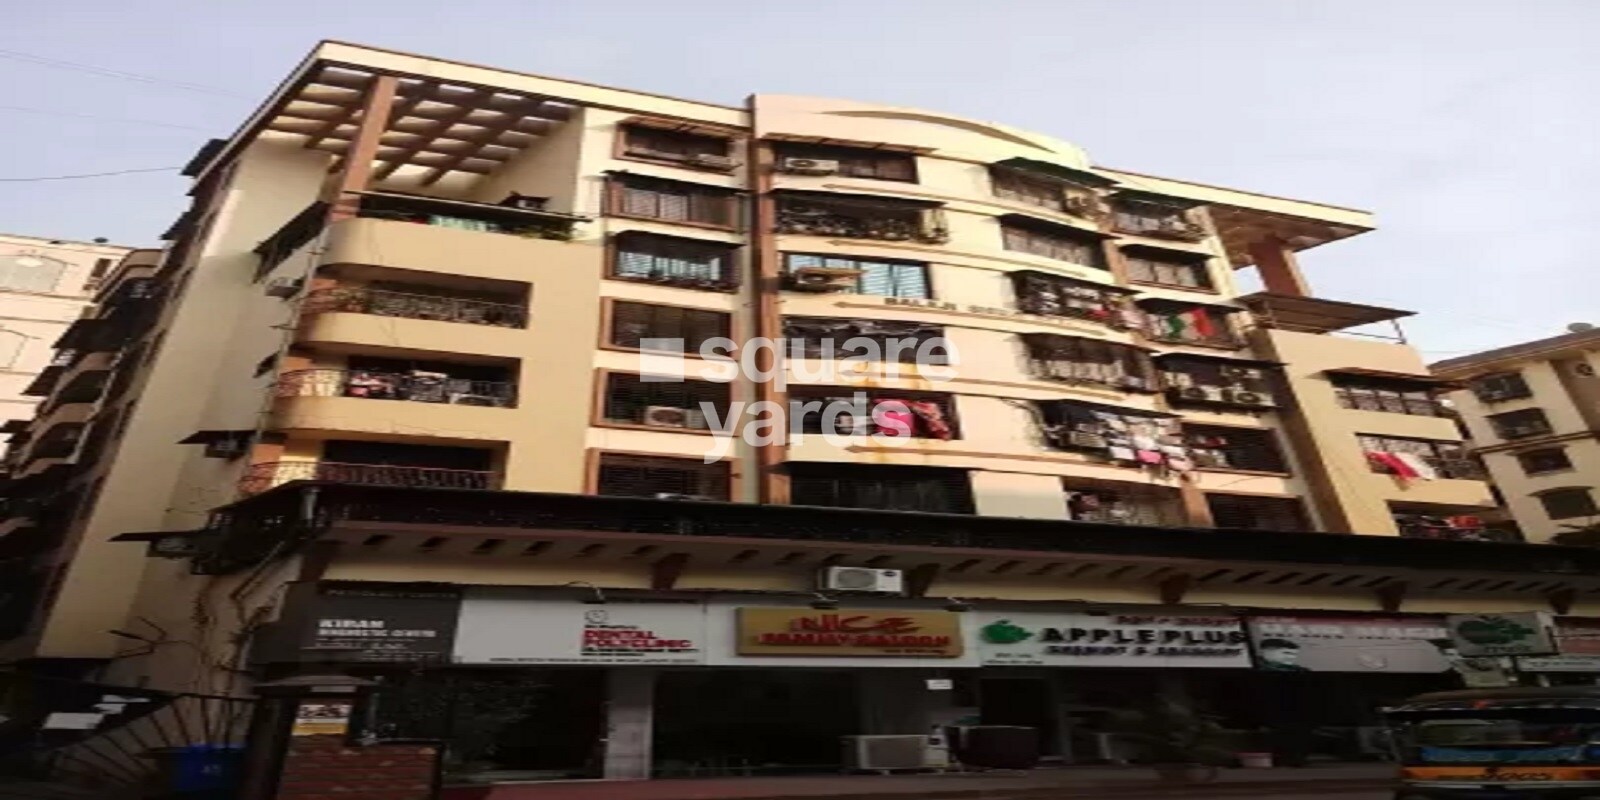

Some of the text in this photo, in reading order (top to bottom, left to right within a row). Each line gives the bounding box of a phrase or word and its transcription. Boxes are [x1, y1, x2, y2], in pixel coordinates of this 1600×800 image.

[583, 630, 656, 640] DENTAL
[1042, 627, 1156, 643] APPLE
[1163, 630, 1247, 644] PLUS
[582, 639, 692, 648] POLYCLINIC
